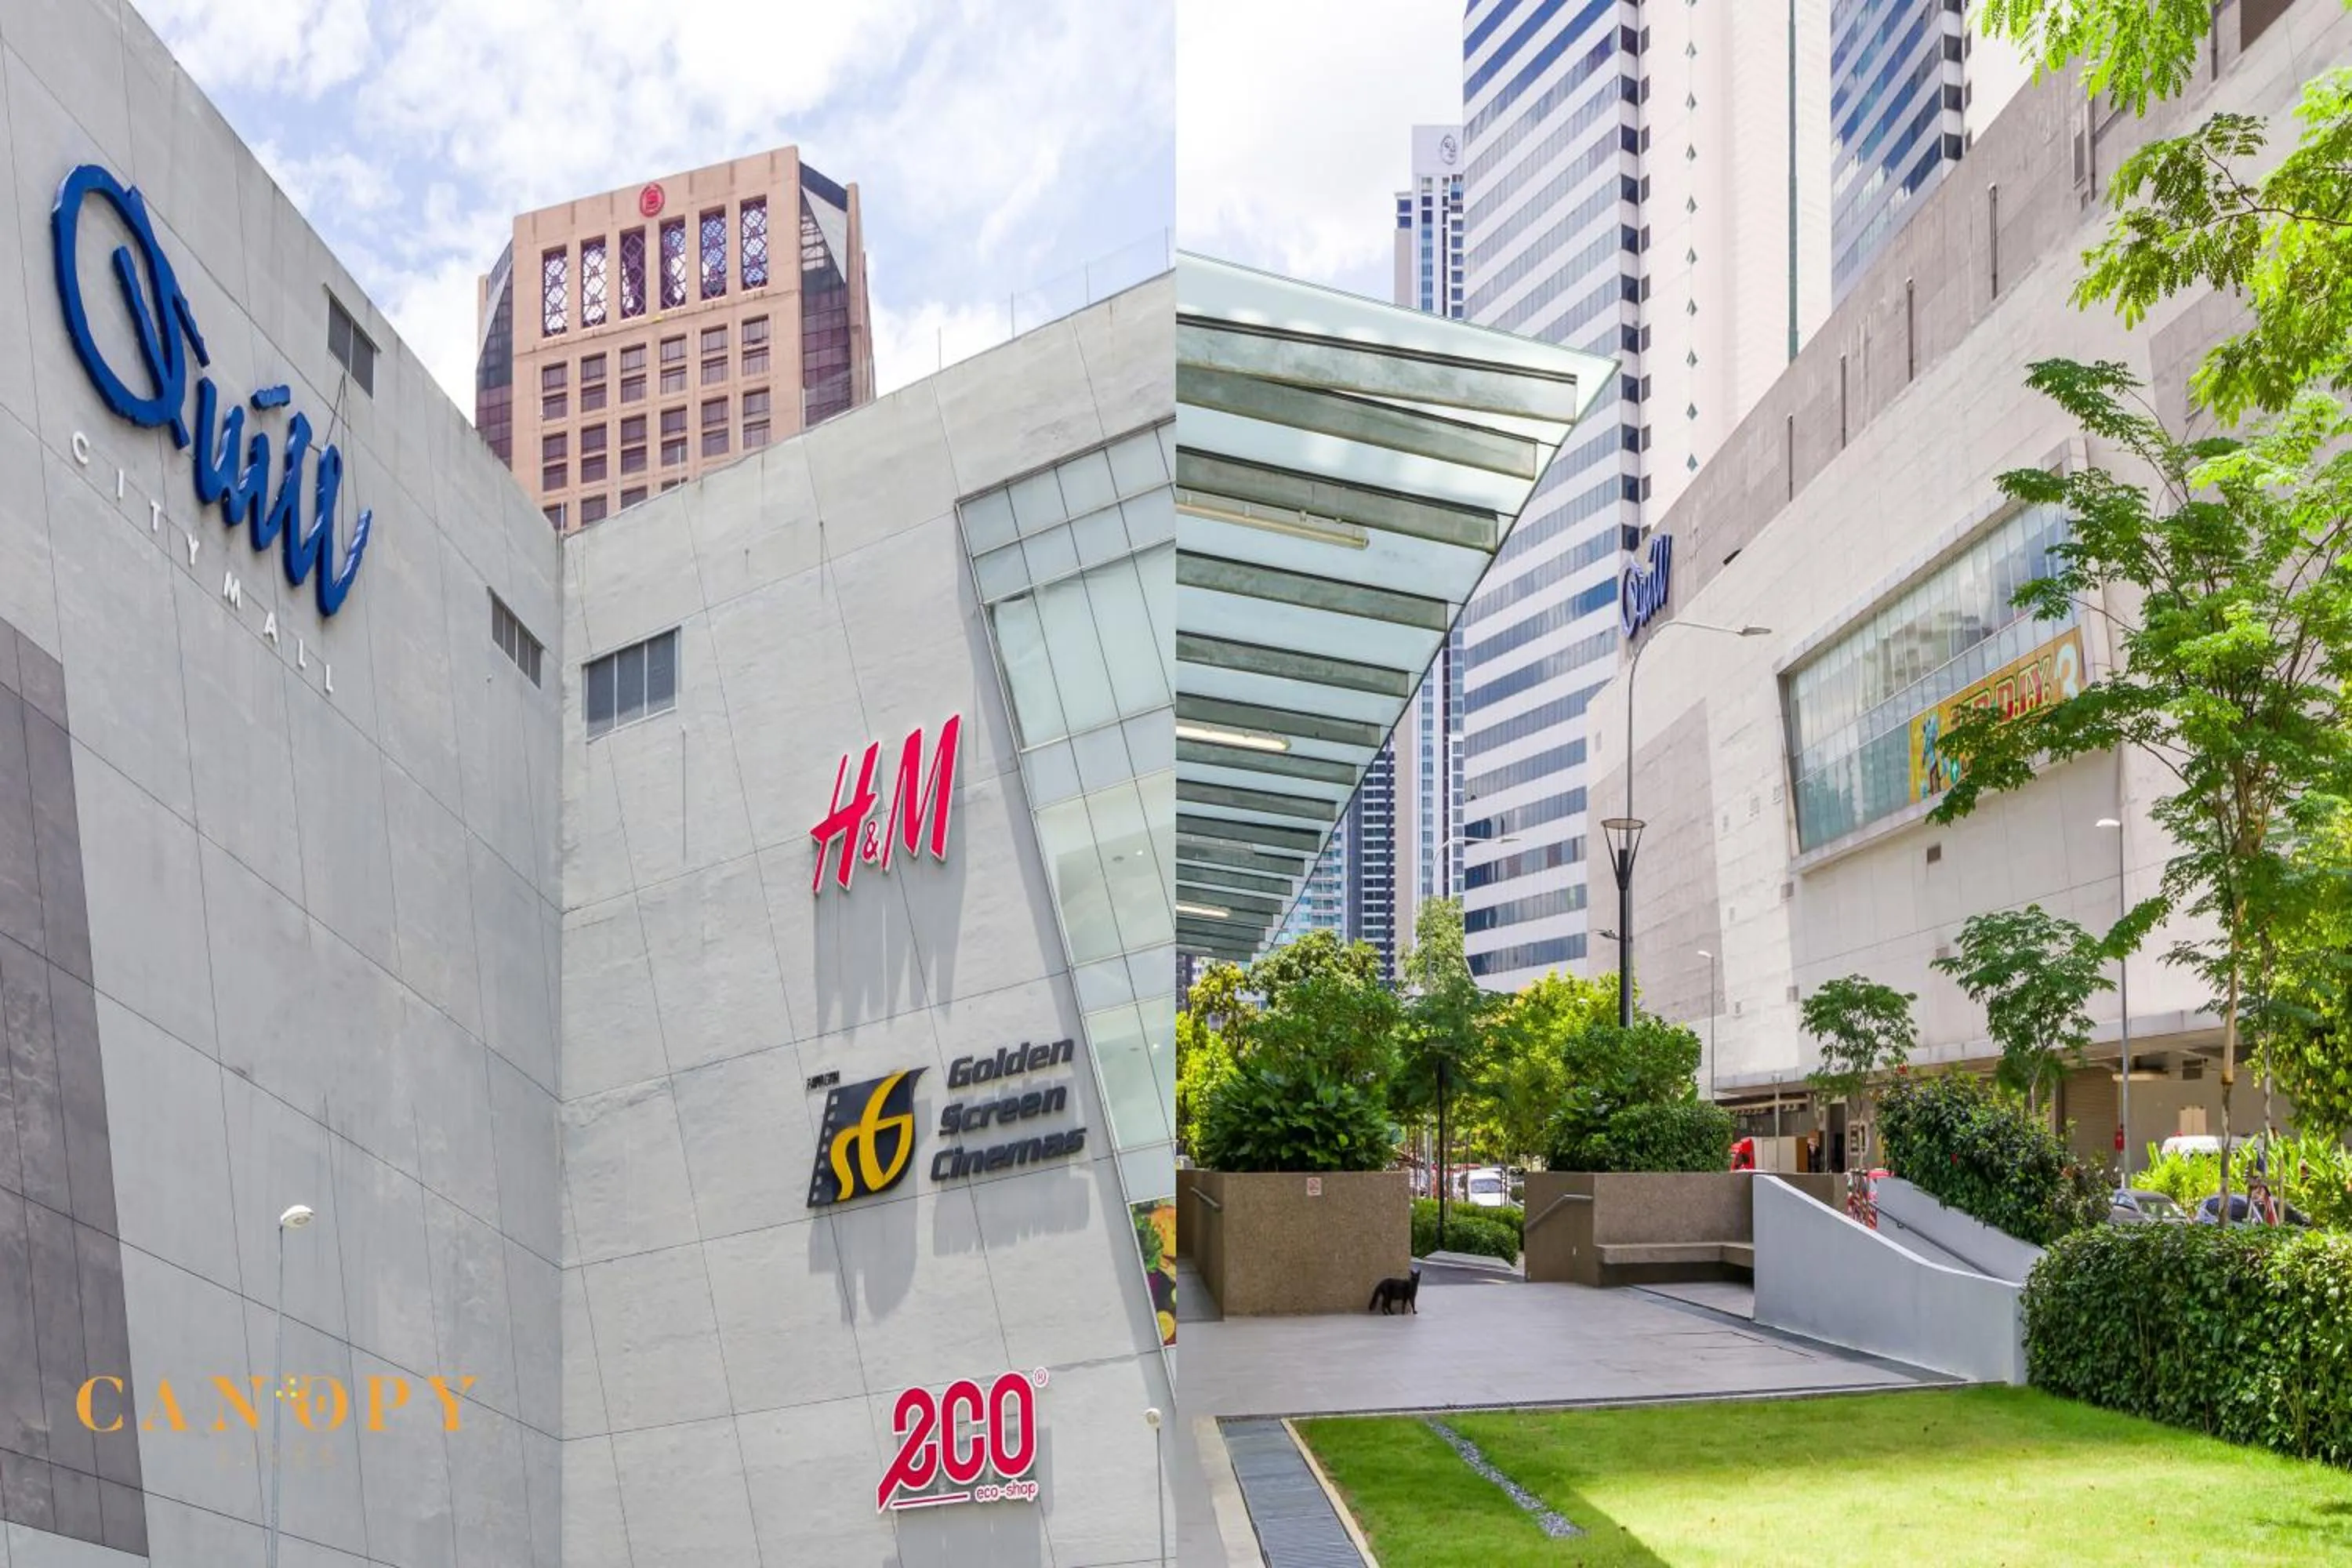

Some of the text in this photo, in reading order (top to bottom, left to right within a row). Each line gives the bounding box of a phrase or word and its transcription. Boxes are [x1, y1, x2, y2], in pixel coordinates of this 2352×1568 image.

[52, 165, 372, 616] Quill
[71, 431, 334, 693] CITY MALL
[809, 713, 964, 896] H&M
[947, 1037, 1075, 1090] Golden
[938, 1084, 1068, 1137] Screen
[930, 1127, 1087, 1181] Cinemas
[974, 1480, 1039, 1503] eco-shop
